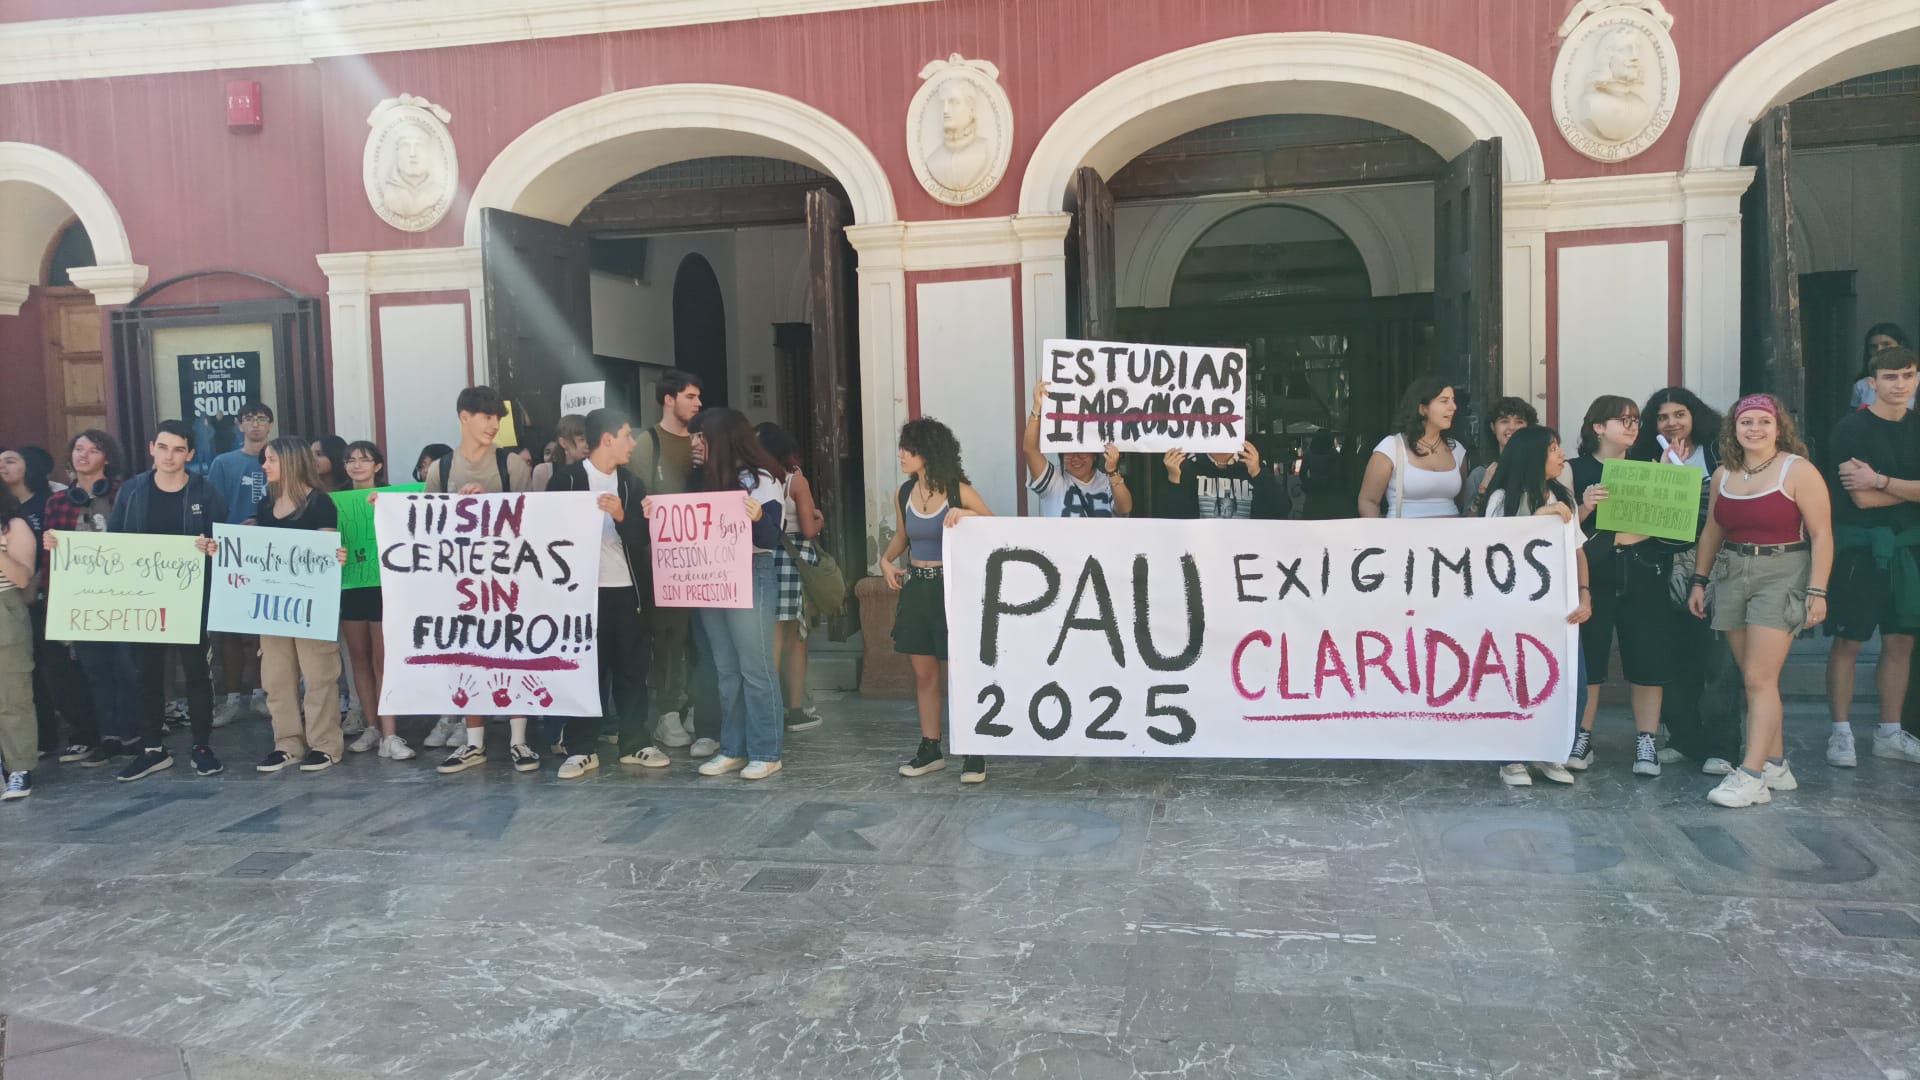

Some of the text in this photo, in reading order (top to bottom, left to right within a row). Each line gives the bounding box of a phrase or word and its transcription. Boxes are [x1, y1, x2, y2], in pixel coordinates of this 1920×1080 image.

[1626, 139, 1643, 154] LA
[1647, 109, 1672, 142] BARCA
[192, 355, 246, 371] tricicle
[1051, 347, 1244, 394] ESTUDIAR
[193, 379, 246, 394] ¡POR FIN
[656, 503, 712, 542] 2007
[54, 537, 124, 575] Nuestro
[381, 537, 579, 592] CERTEZAS,
[714, 546, 735, 563] CON
[1233, 539, 1553, 602] EXIGIMOS
[456, 576, 519, 614] SIN
[662, 584, 681, 600] SIN
[979, 546, 1205, 672] PAU
[70, 607, 166, 632] RESPETO!
[412, 613, 593, 654] FUTURO!!!
[974, 681, 1197, 745] 2025
